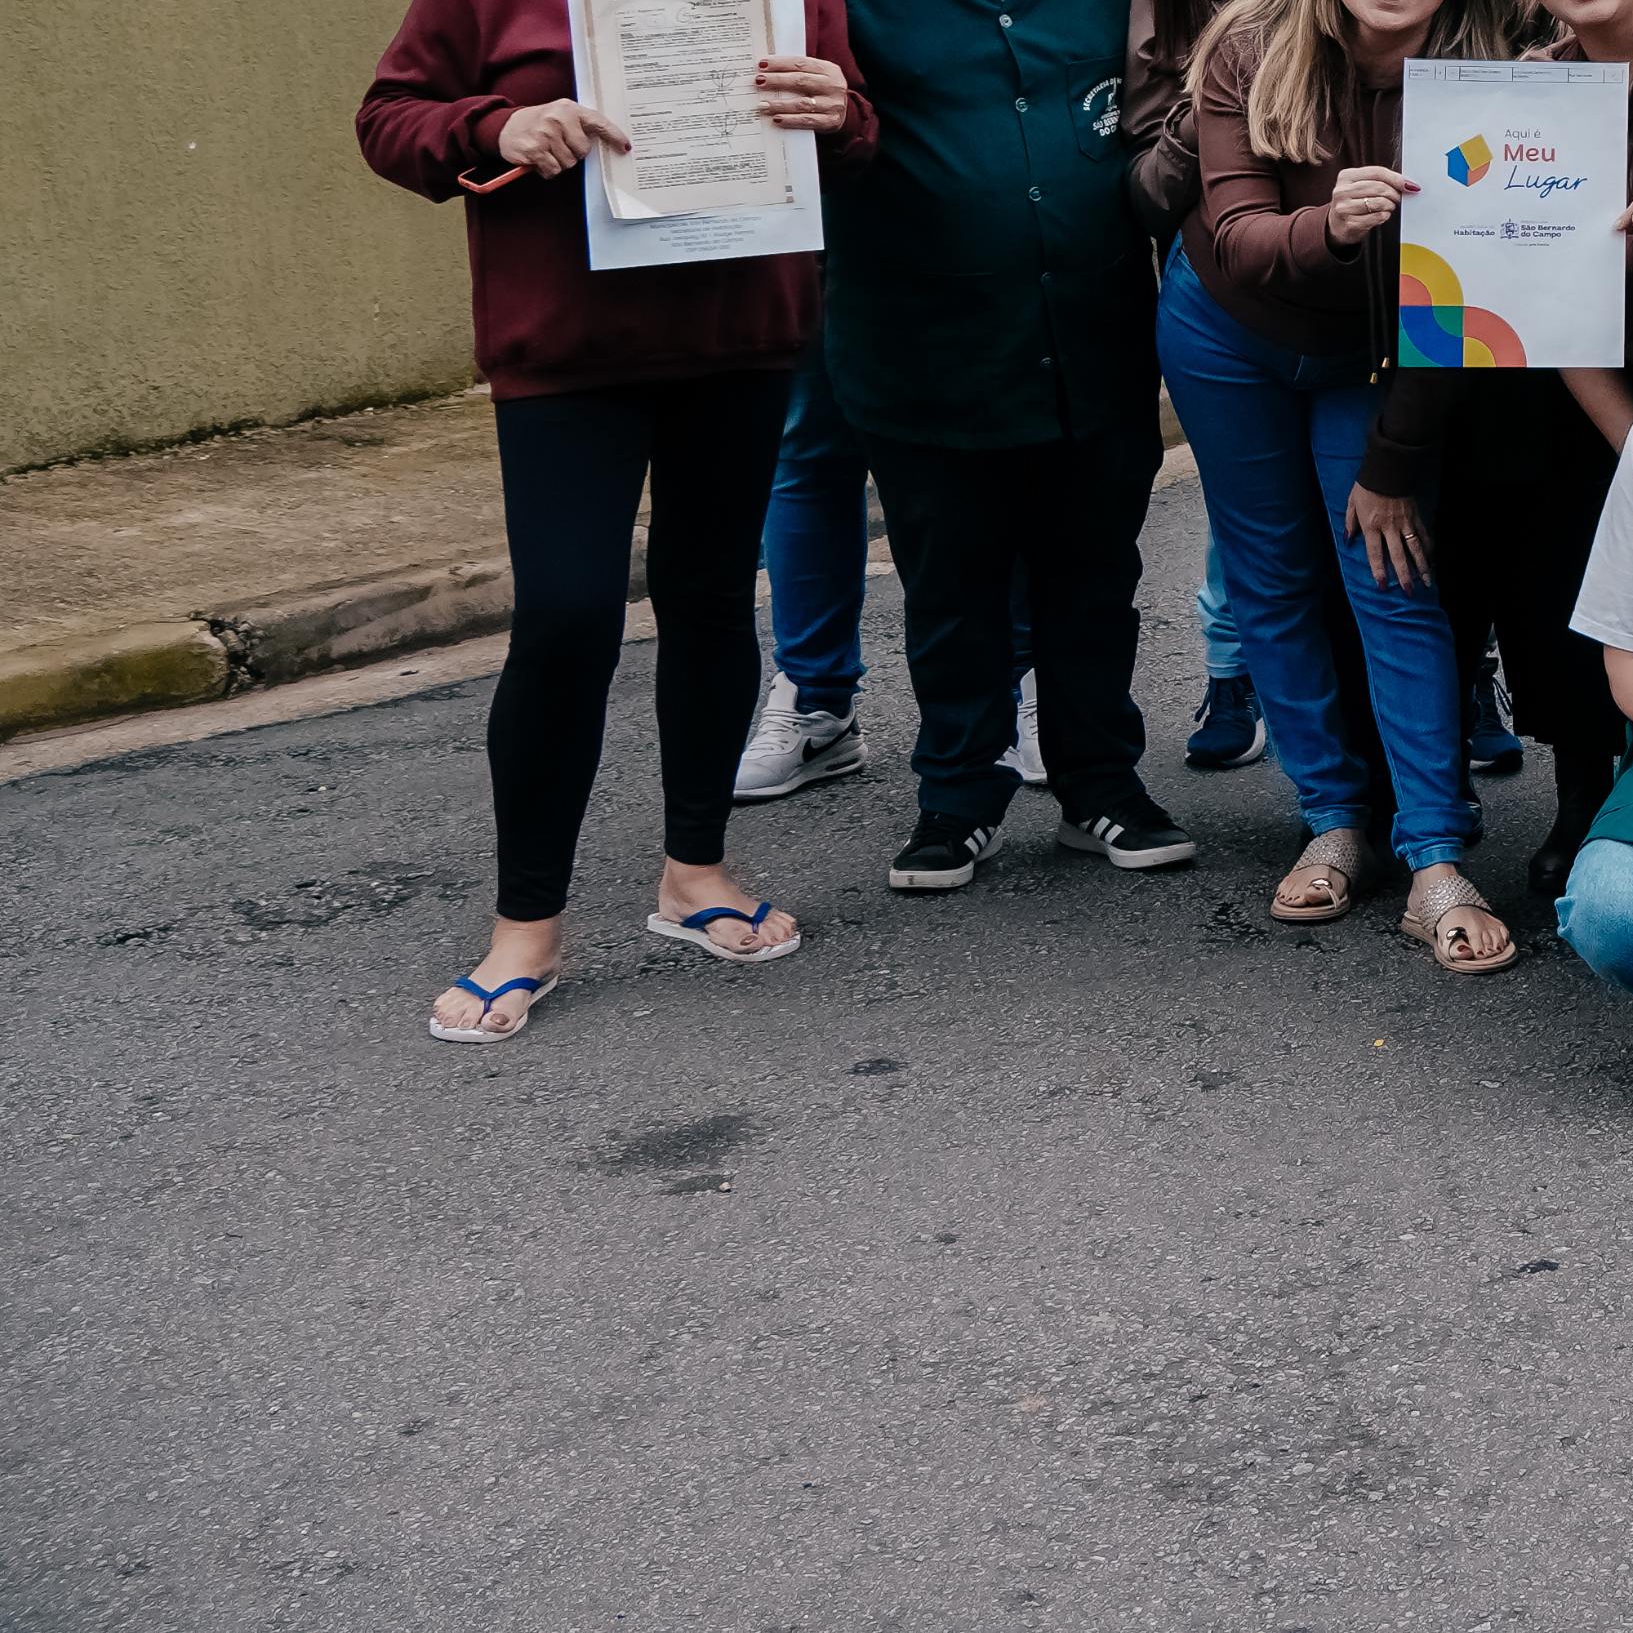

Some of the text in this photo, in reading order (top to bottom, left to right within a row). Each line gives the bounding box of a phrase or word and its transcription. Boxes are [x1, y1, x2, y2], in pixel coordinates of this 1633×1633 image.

[1505, 129, 1541, 141] Aqui é
[1504, 143, 1555, 162] Meu
[1504, 165, 1588, 198] Lugar
[1520, 224, 1576, 232] São Bernardo
[1532, 231, 1562, 239] Campo
